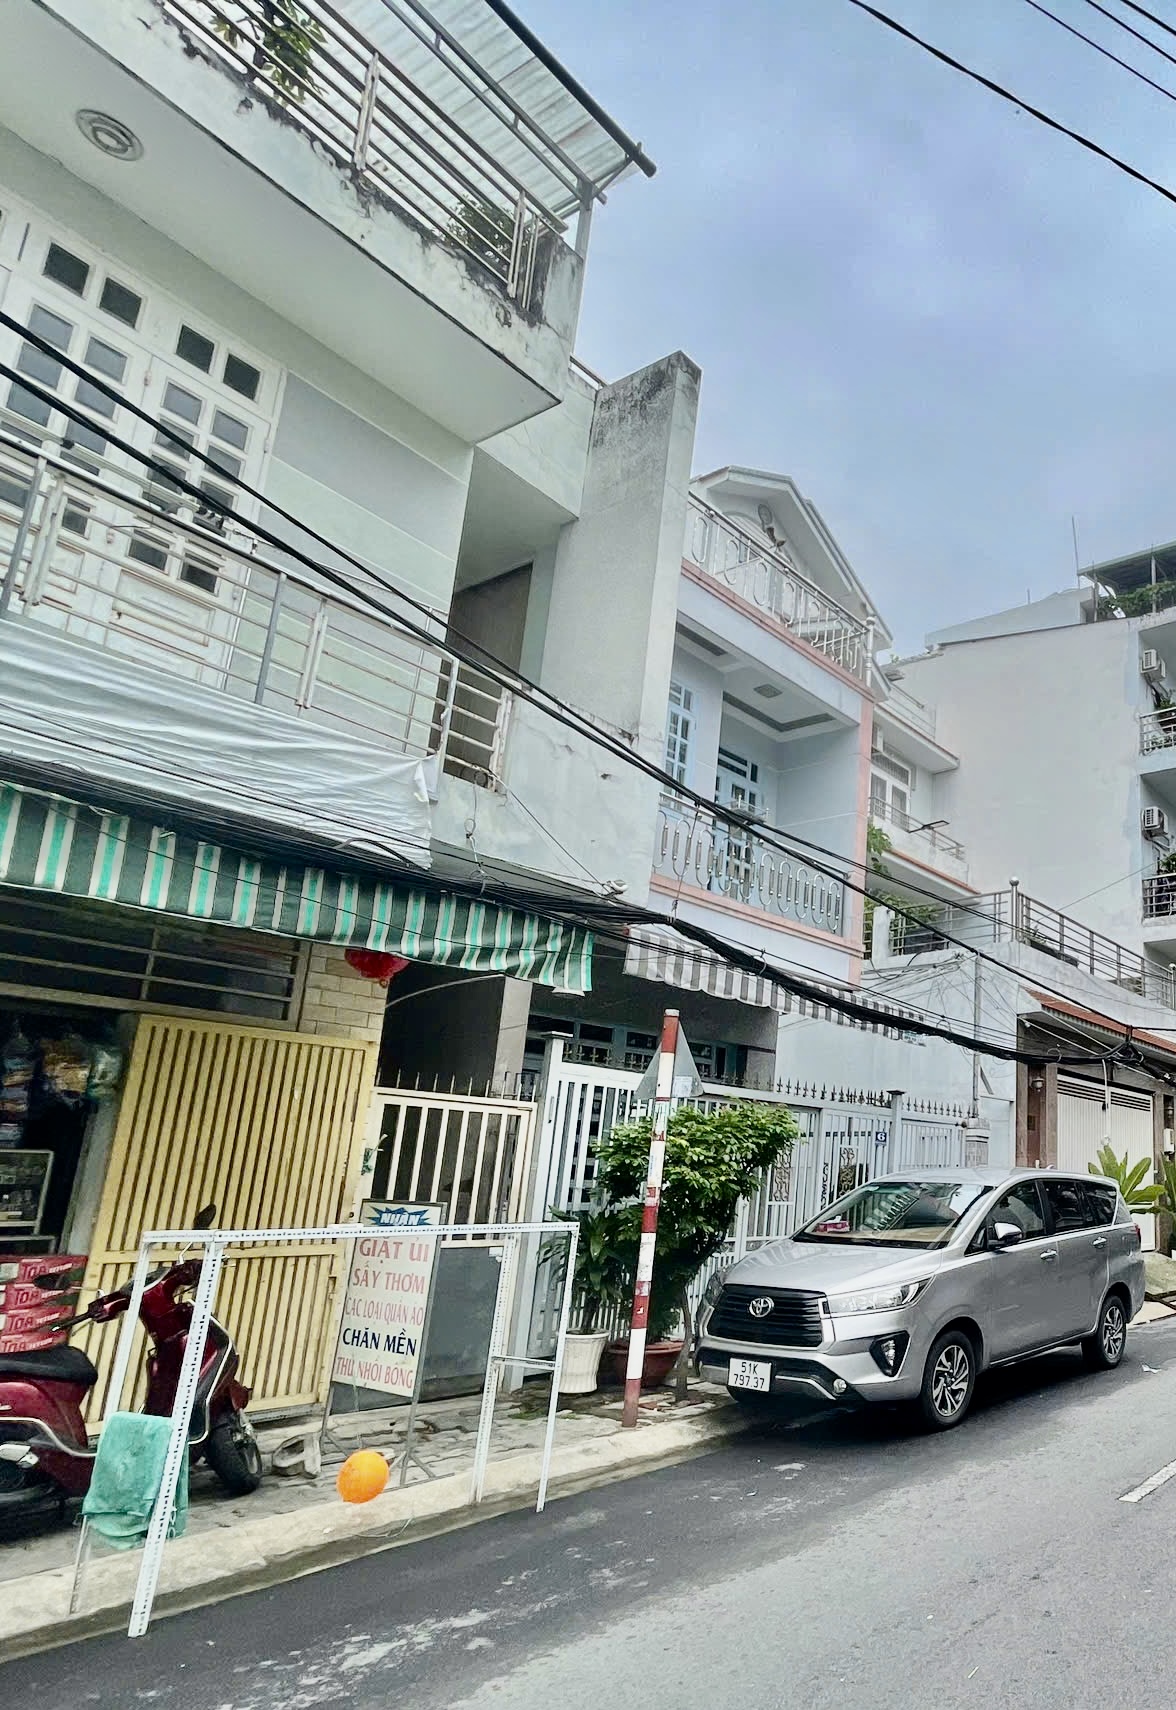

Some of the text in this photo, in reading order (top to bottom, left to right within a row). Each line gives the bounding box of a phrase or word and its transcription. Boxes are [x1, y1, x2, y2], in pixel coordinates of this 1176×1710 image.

[877, 1132, 886, 1141] 6
[359, 1236, 403, 1263] GIẶT
[352, 1261, 425, 1294] SẤY THƠM
[342, 1327, 417, 1356] CHĂN MỀN
[741, 1361, 758, 1375] 51K
[733, 1373, 765, 1389] 797.37
